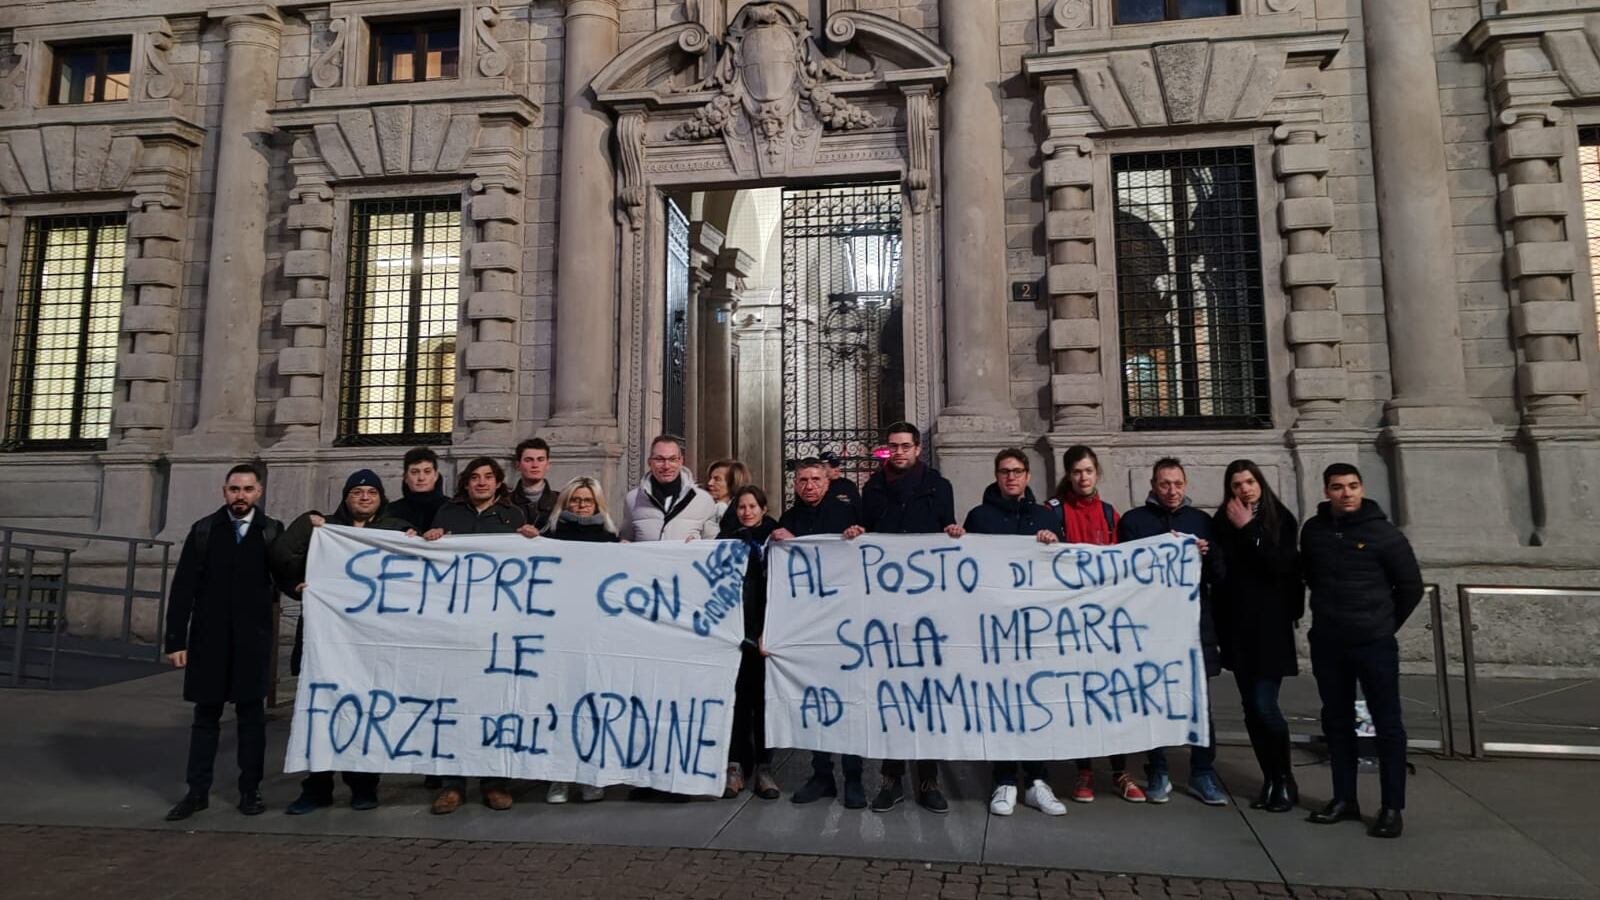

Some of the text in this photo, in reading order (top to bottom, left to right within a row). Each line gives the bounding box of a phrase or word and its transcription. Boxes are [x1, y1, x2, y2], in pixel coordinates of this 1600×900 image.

[1022, 283, 1031, 298] 2
[344, 548, 681, 622] SEMPRE CON
[788, 544, 838, 598] AL
[860, 543, 979, 595] POSTO
[1009, 560, 1033, 588] DI
[483, 632, 546, 677] LE
[836, 603, 1149, 671] SALA IMPARA
[800, 647, 1201, 744] AD AMMINISTRARE!
[304, 682, 725, 780] FORZE DELL' ORDINE
